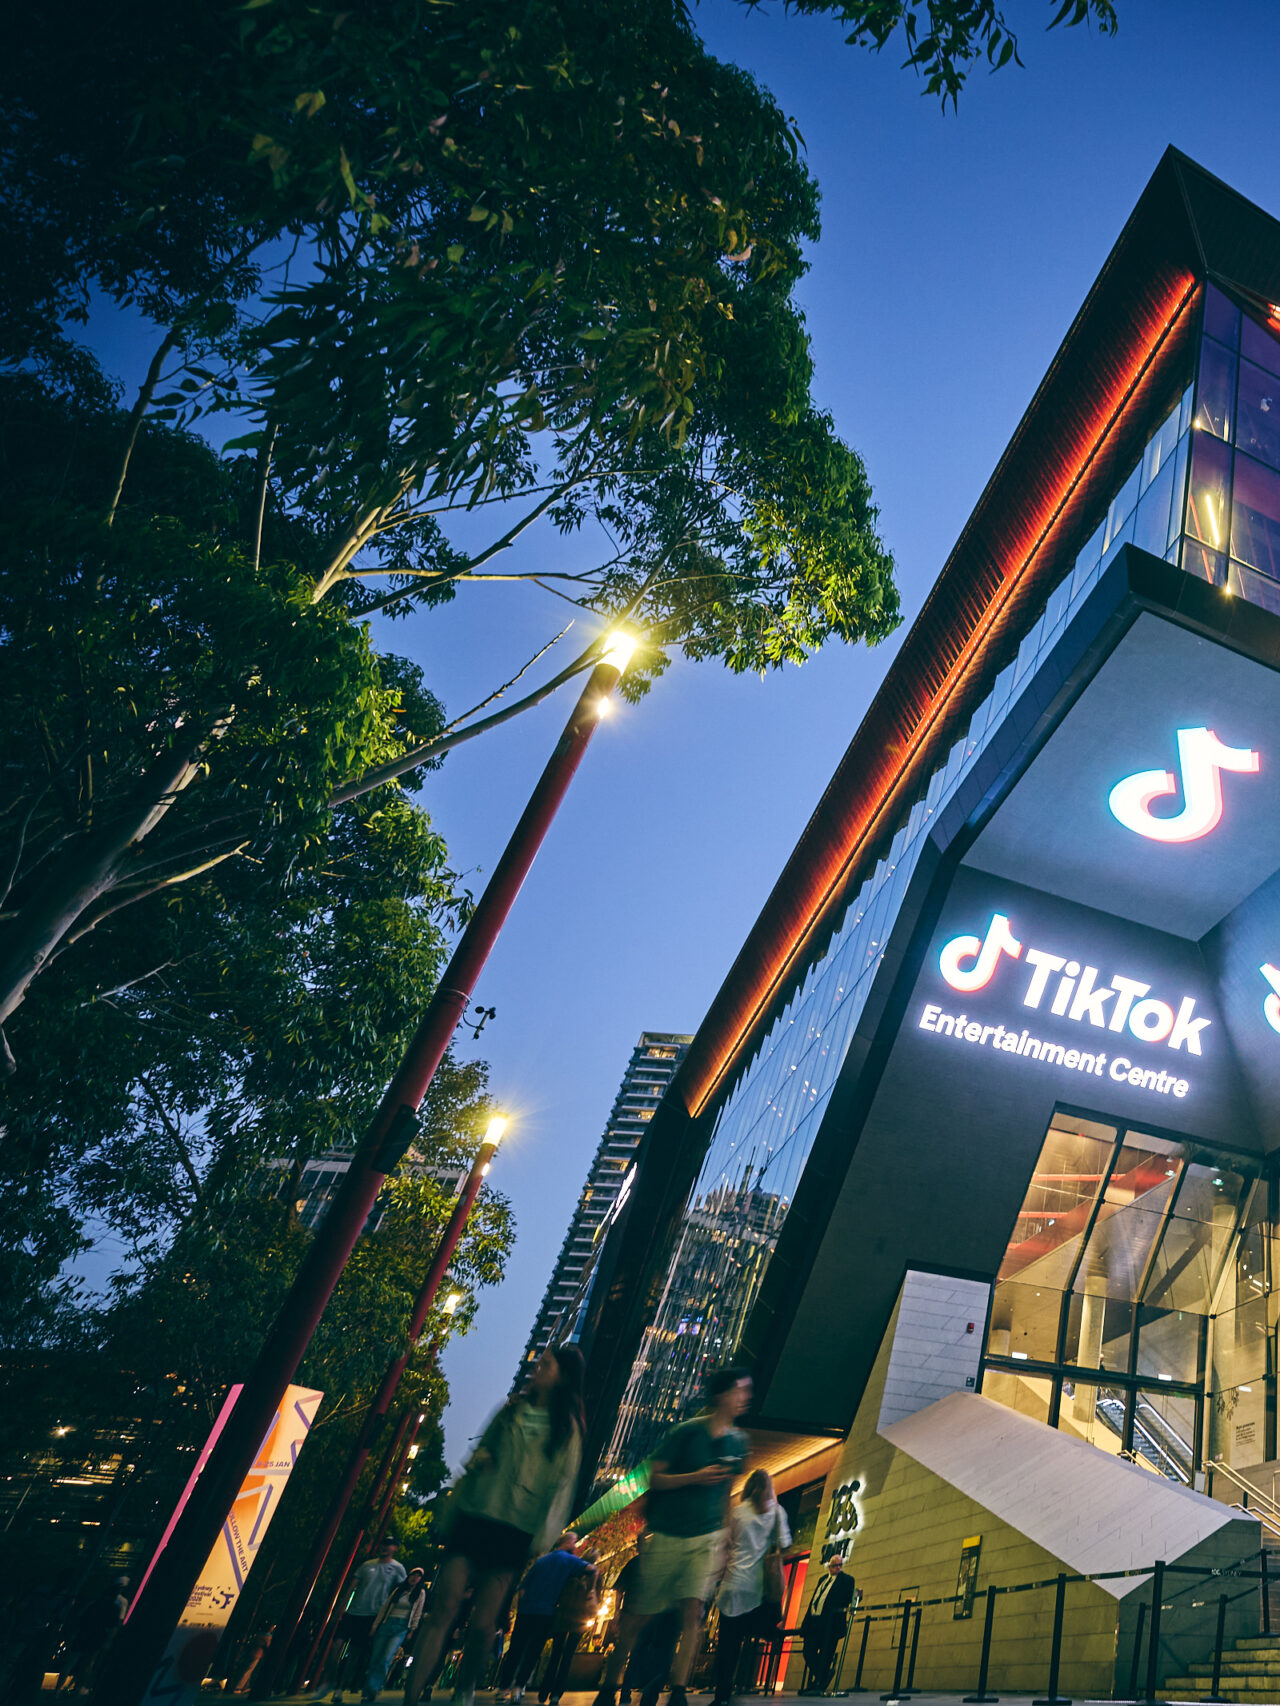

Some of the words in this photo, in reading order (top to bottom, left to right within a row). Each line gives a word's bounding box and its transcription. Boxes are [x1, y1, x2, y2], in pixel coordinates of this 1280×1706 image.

[918, 1004, 1107, 1077] Entertainment
[1109, 1057, 1189, 1098] Centre
[1024, 948, 1211, 1056] TikTok
